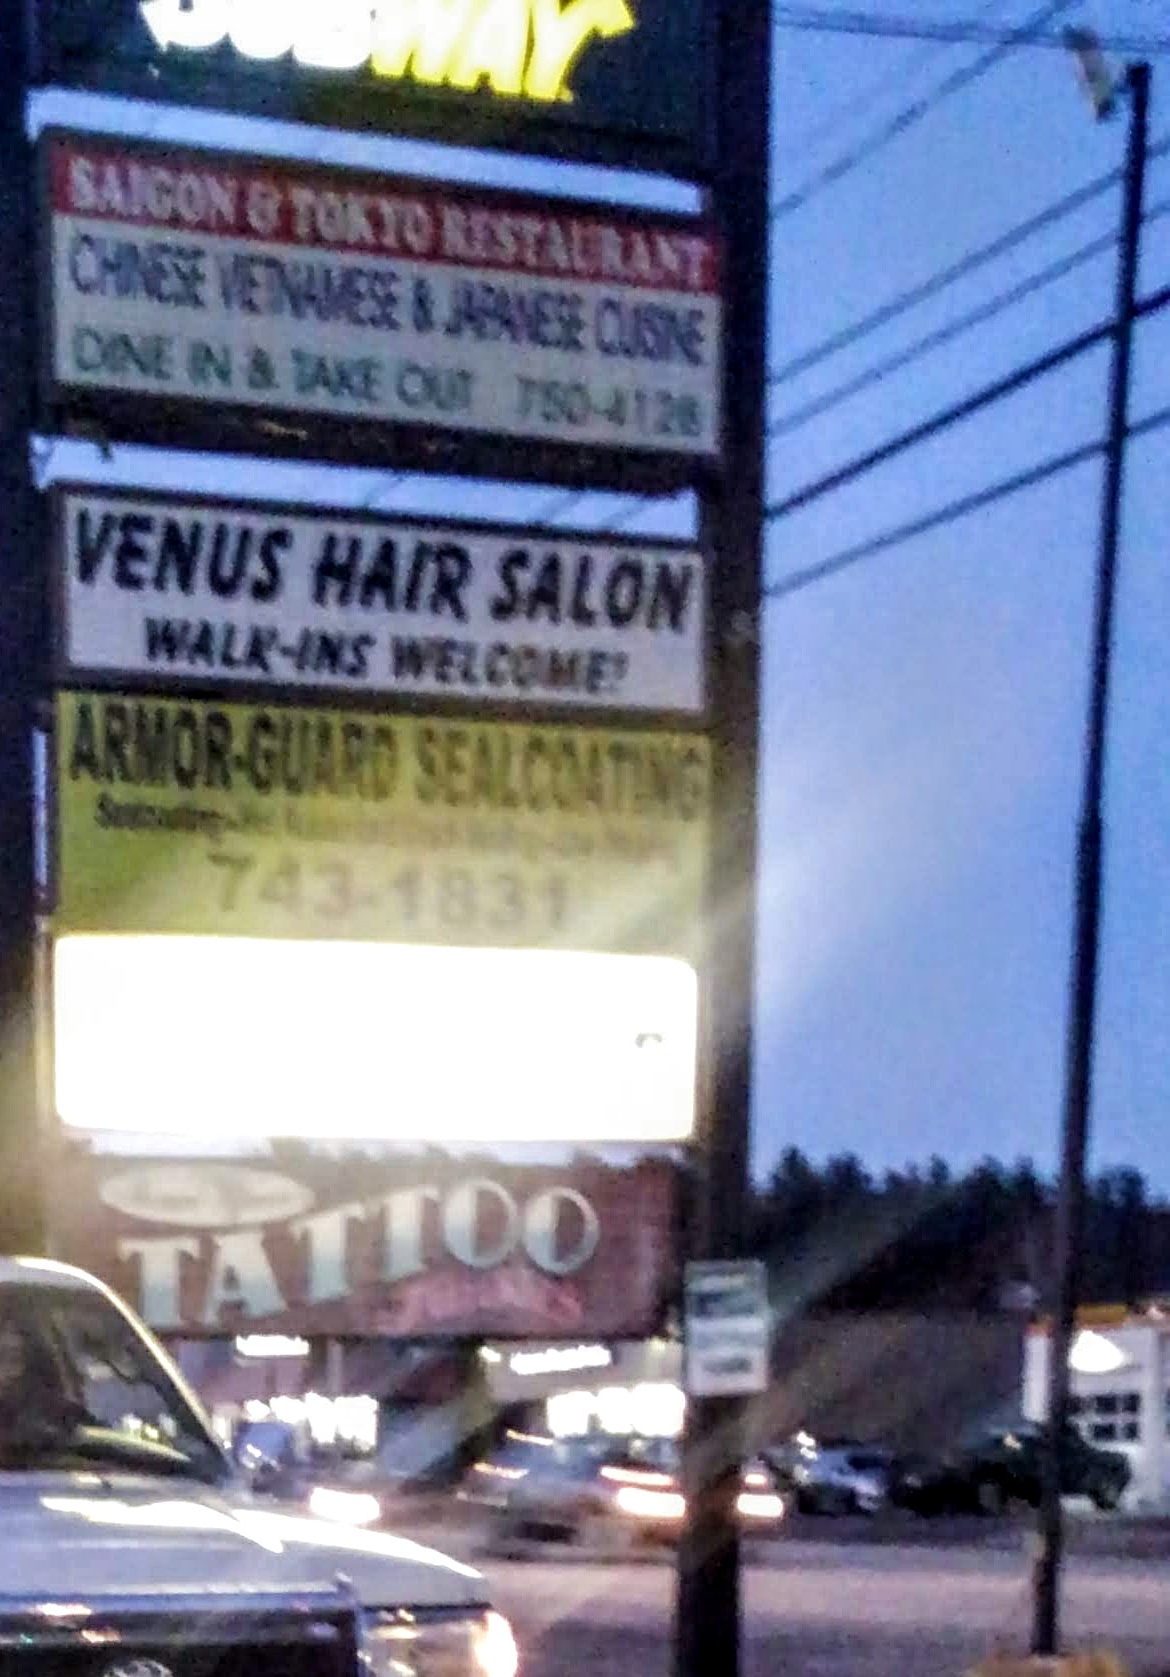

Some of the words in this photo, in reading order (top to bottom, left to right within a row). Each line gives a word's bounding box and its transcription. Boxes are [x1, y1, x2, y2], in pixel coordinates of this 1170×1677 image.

[70, 231, 206, 312] CHINESE
[71, 157, 236, 227] SAIGON
[441, 204, 711, 289] RESTAURANT
[74, 326, 173, 382] DINE
[187, 340, 232, 390] IN
[291, 348, 382, 403] TAKE
[396, 361, 473, 413] OUT
[76, 507, 294, 600] VENUS
[312, 533, 474, 624] HAIR
[490, 549, 695, 636] SALON
[143, 616, 377, 679] WALK-INS
[118, 1175, 600, 1330] TATTOO
